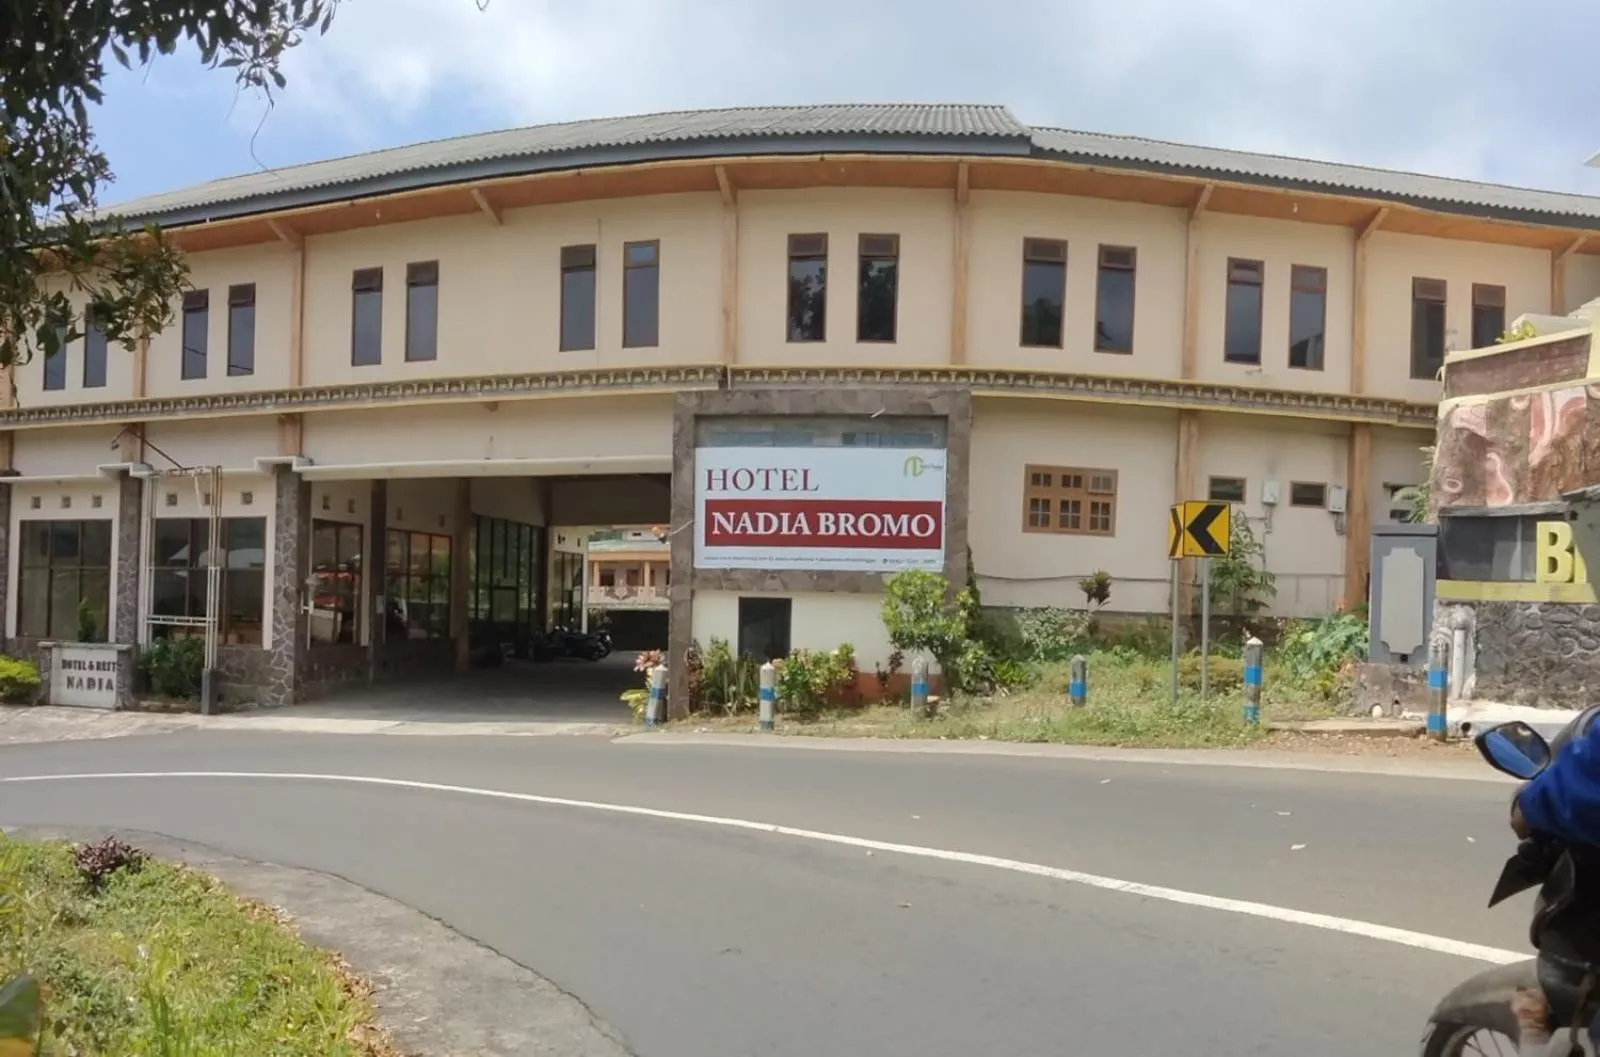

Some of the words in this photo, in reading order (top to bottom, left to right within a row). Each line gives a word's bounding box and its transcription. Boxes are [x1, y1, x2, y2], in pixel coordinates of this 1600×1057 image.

[705, 467, 820, 492] HOTEL
[711, 511, 812, 536] NADIA
[816, 512, 936, 537] BROMO
[1536, 521, 1587, 584] B
[61, 659, 87, 671] HOTEL
[66, 676, 114, 692] NADIA
